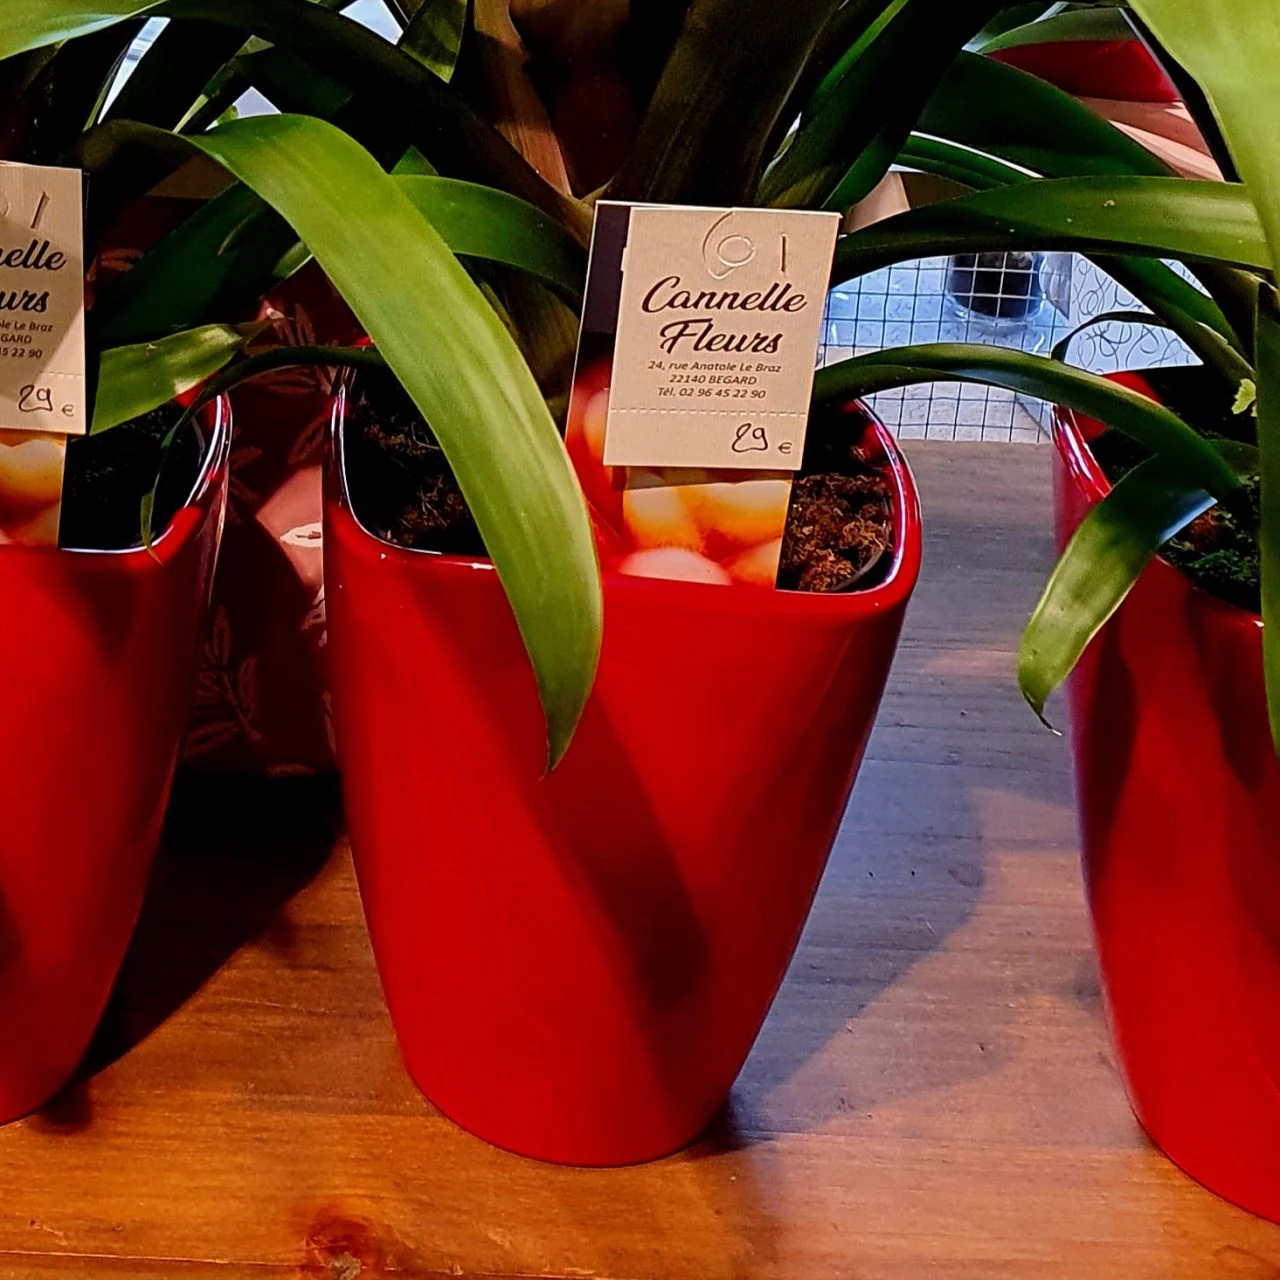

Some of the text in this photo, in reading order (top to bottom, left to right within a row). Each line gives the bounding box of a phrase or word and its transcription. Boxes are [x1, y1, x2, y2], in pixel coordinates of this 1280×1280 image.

[641, 275, 808, 313] Cannelle
[14, 321, 27, 331] Le
[29, 321, 54, 332] Braz
[659, 318, 783, 355] Fleurs
[11, 348, 26, 357] 22
[28, 349, 43, 359] 90
[647, 360, 782, 372] 24, rue Anatole Le Braz
[669, 374, 758, 385] 22140 BEGARD
[658, 387, 767, 399] Tél. 02 96 45 22 90
[18, 383, 75, 417] 29 €
[731, 422, 793, 455] 29 €
